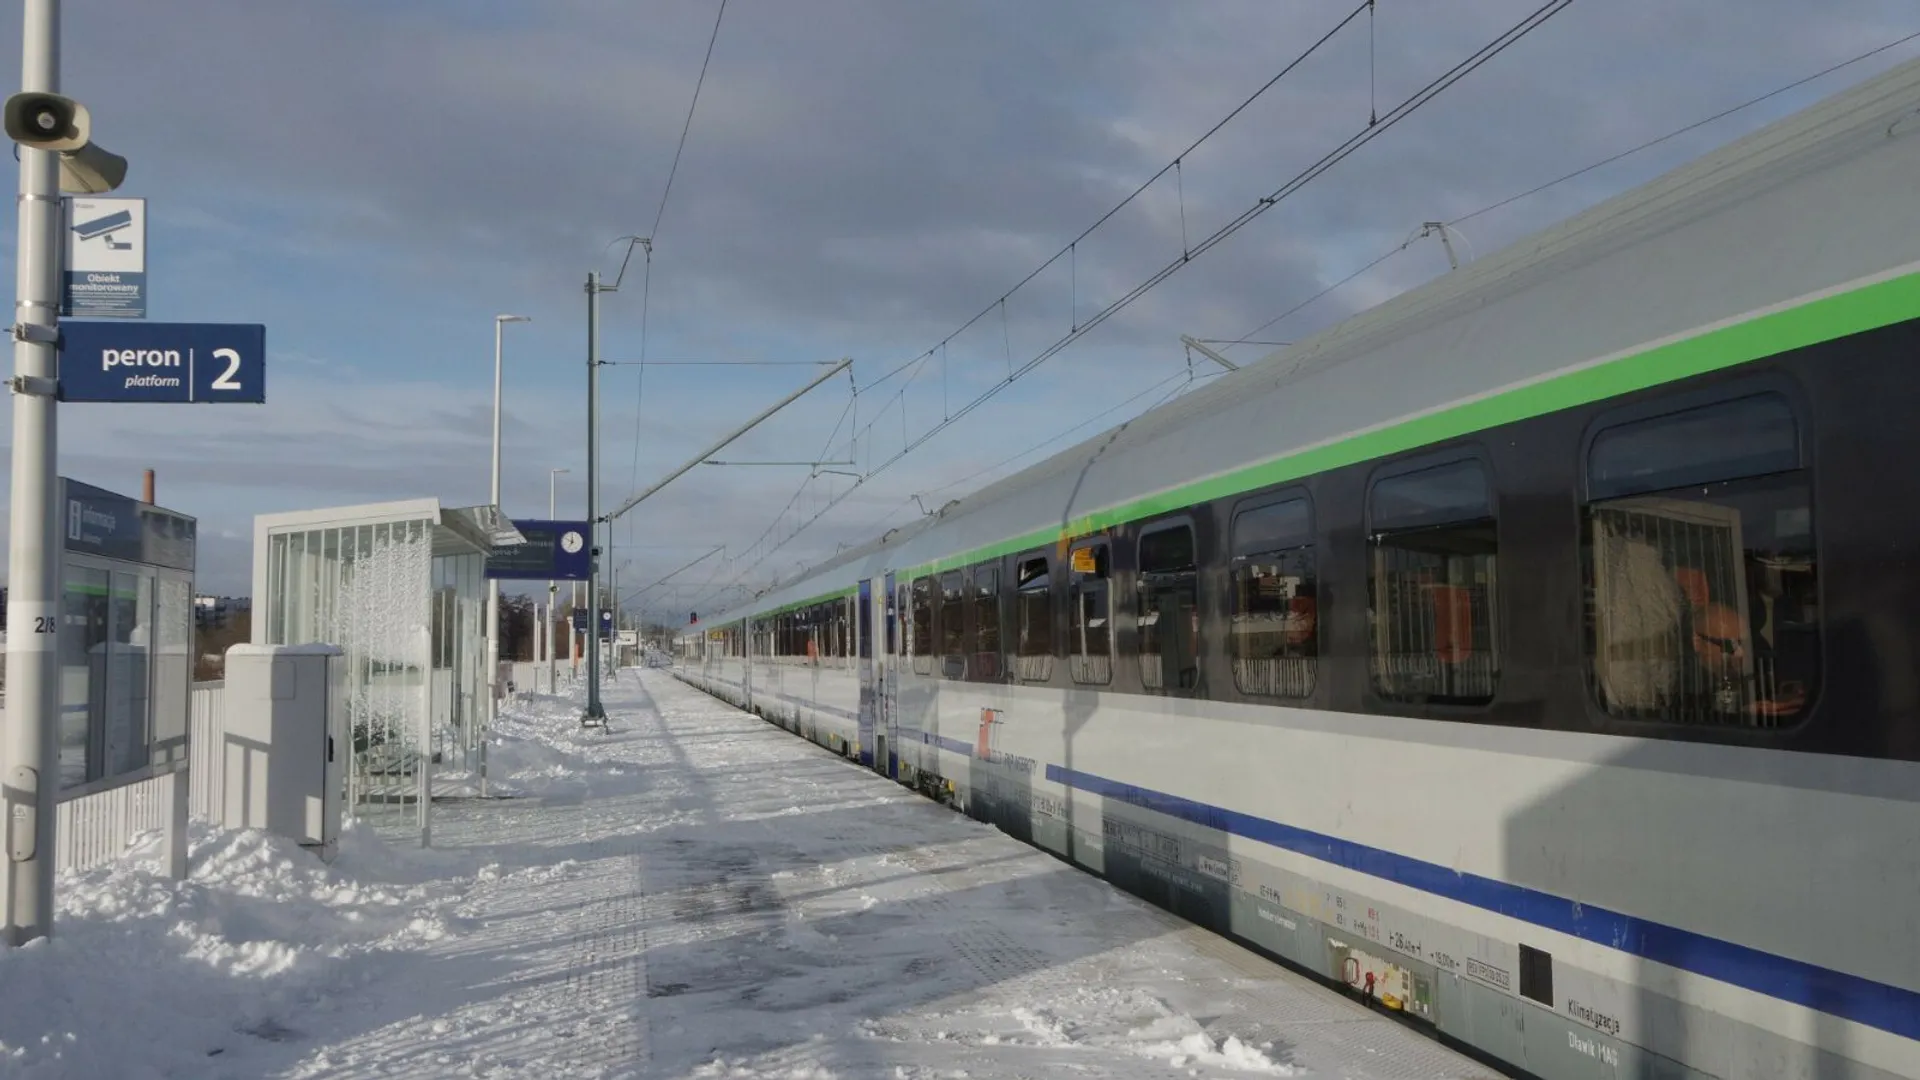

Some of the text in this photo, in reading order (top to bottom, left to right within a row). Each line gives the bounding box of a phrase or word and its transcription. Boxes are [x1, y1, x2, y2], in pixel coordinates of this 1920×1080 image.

[87, 274, 120, 282] Obiekt
[102, 347, 242, 390] peron 2
[124, 374, 180, 389] platform
[1567, 998, 1620, 1035] Klimatyzacja
